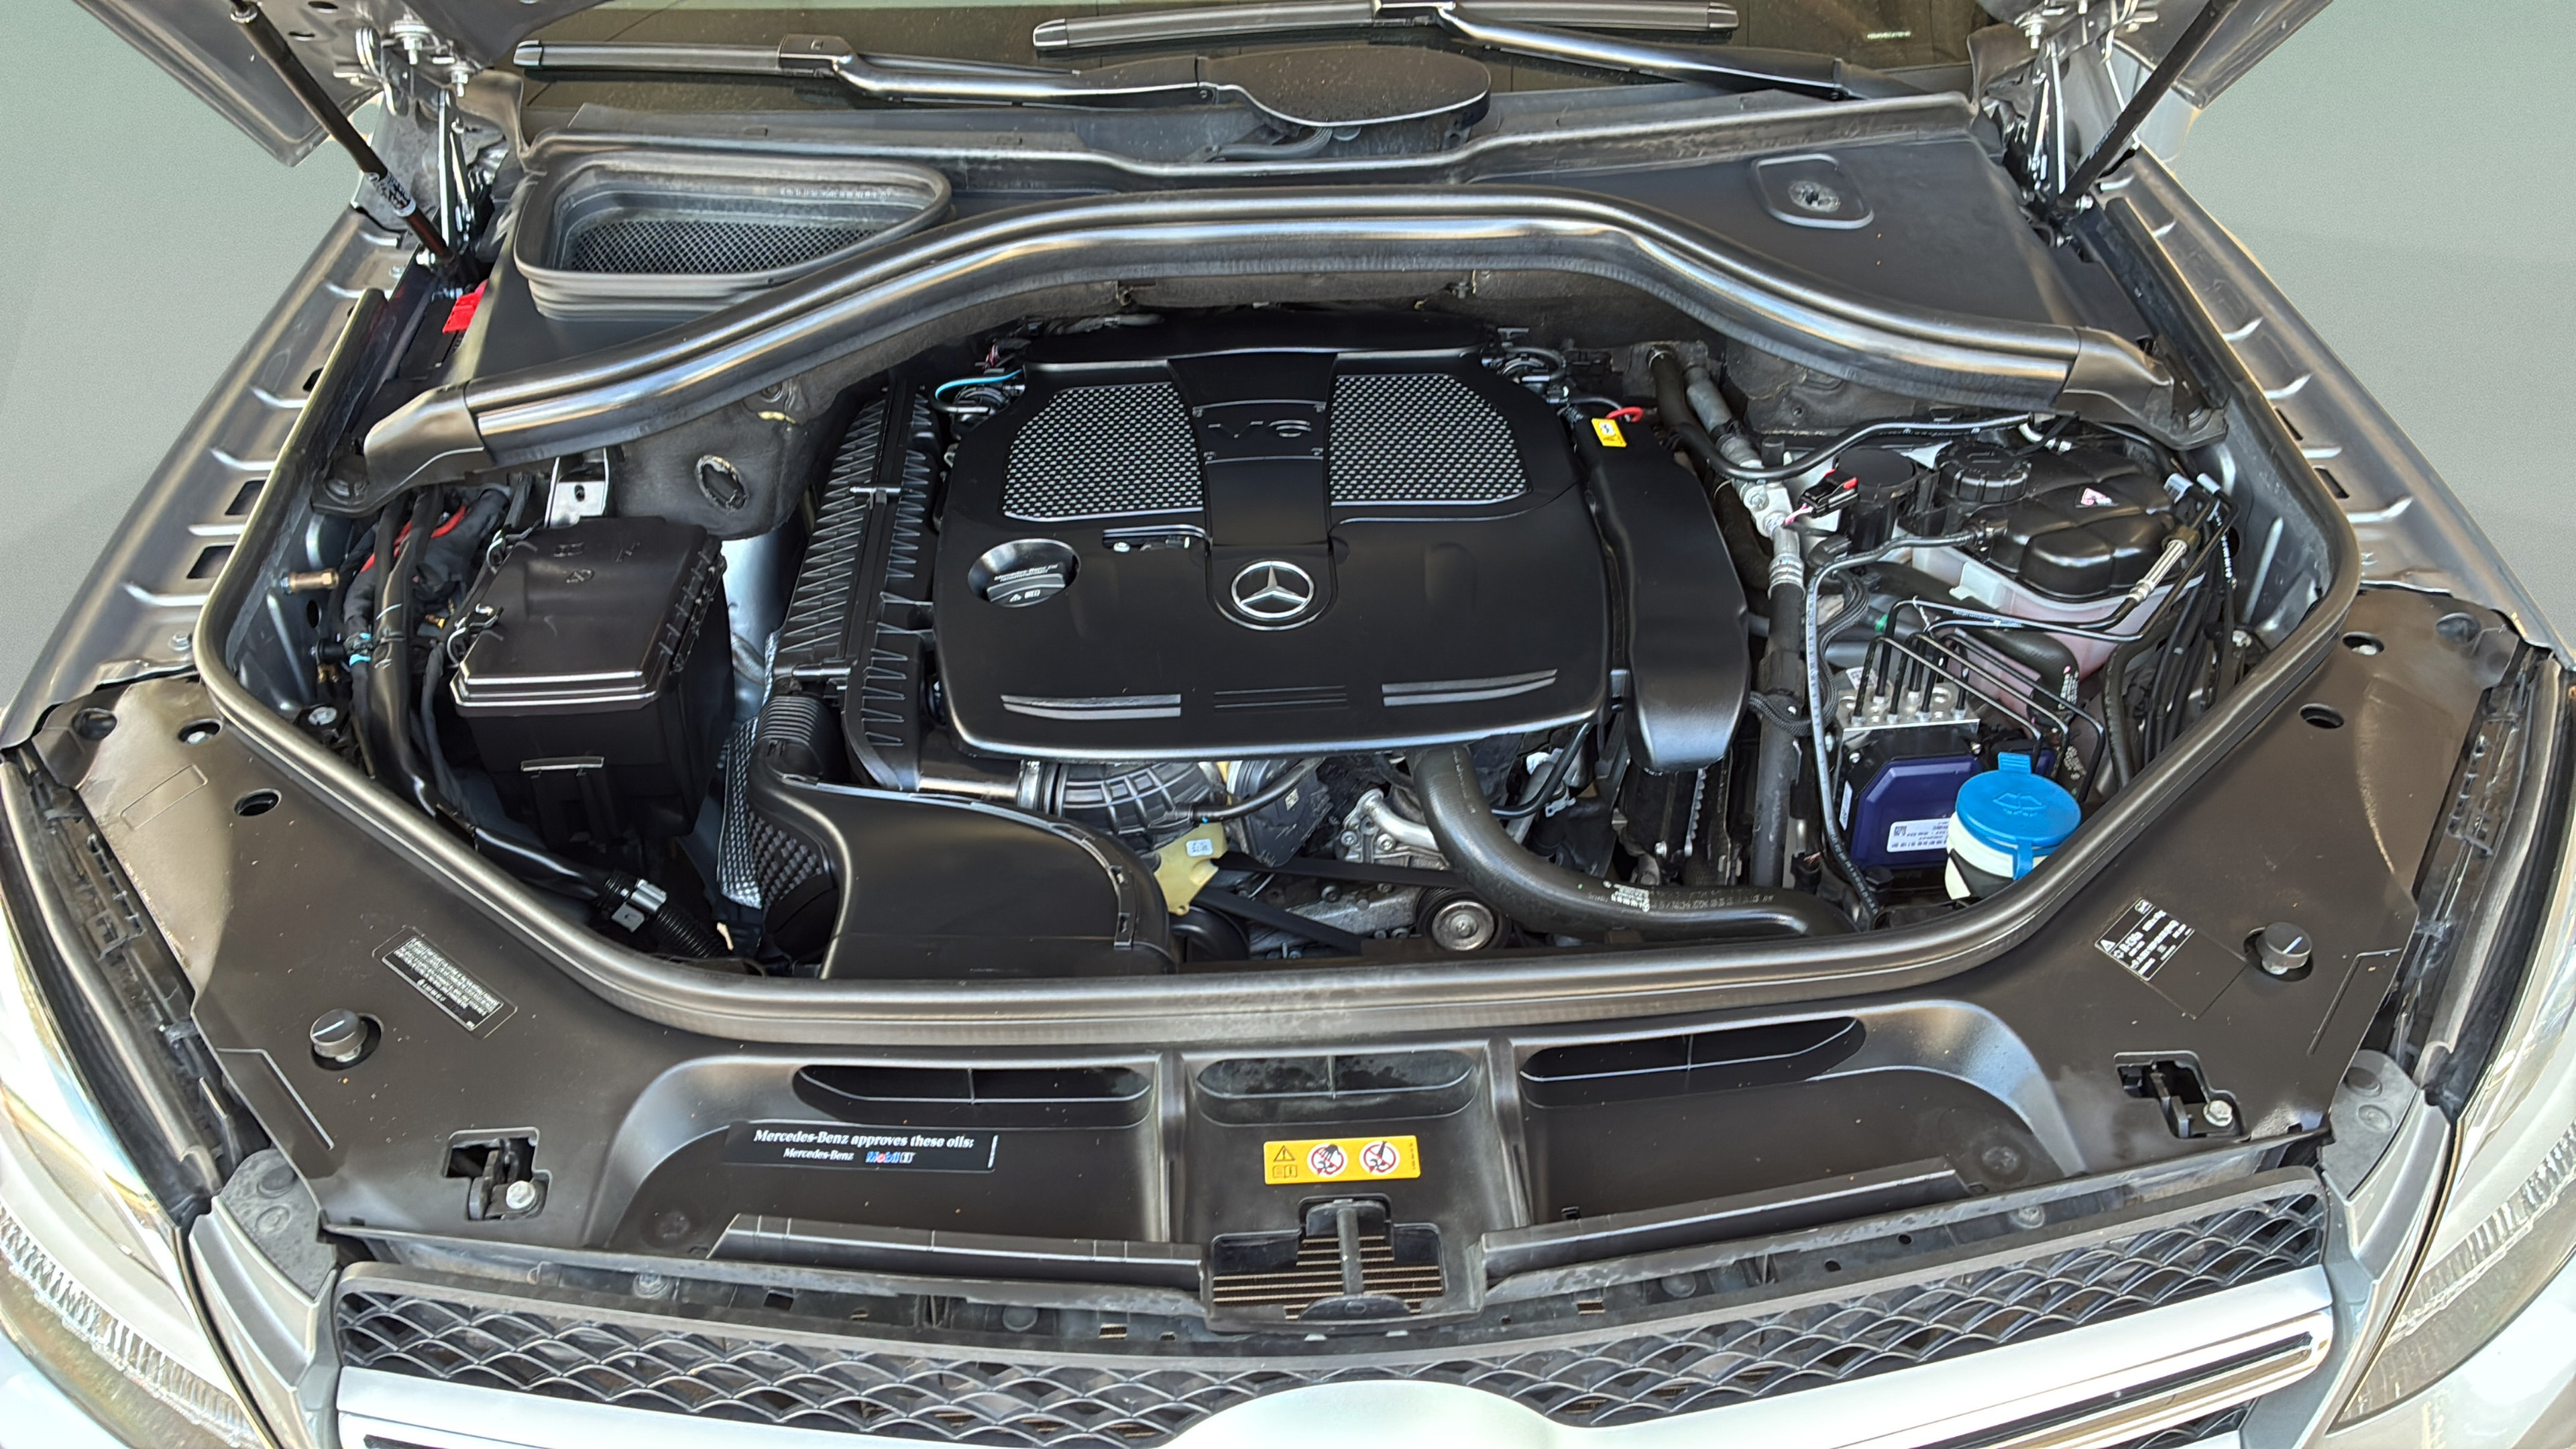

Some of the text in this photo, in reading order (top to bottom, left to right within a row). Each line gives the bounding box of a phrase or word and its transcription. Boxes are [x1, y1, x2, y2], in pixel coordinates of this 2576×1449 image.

[754, 1129, 975, 1148] Mercedes-Benz approves these oils:
[783, 1147, 855, 1161] Mercedes-Benz
[864, 1150, 900, 1164] Mobil
